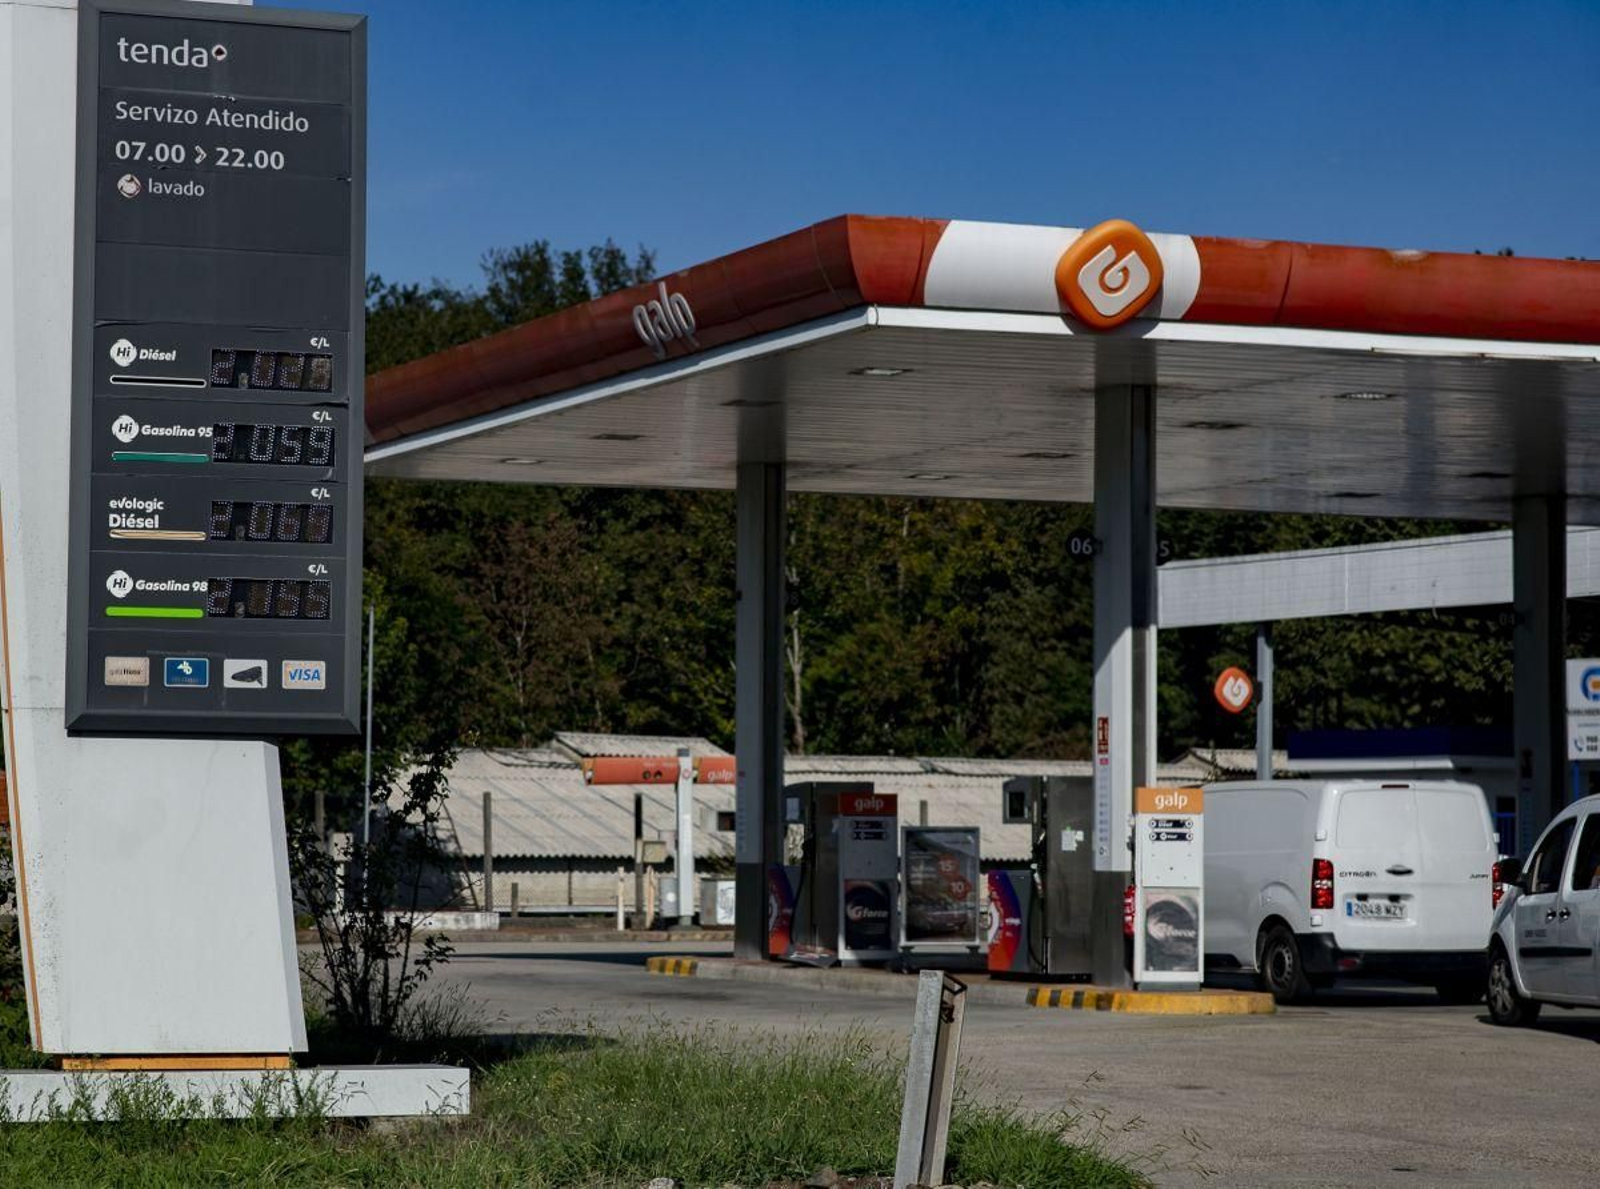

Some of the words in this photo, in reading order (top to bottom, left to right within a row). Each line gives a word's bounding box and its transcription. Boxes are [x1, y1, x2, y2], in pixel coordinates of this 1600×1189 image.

[117, 37, 209, 68] tenda
[115, 101, 198, 125] Servizo
[205, 107, 309, 133] Atendido
[115, 140, 186, 164] 07.00
[215, 147, 285, 170] 22.00
[148, 177, 205, 197] lavado
[633, 281, 699, 360] galp
[139, 348, 177, 361] Diésel
[141, 424, 196, 438] Gasolina
[197, 426, 213, 438] 95
[108, 496, 165, 512] evologic
[108, 513, 160, 529] Diésel
[1070, 537, 1093, 555] 06
[135, 579, 191, 593] Gasolina
[192, 580, 208, 592] 98
[289, 668, 321, 681] VISA
[707, 770, 735, 782] galp
[854, 794, 885, 811] galp
[1154, 791, 1188, 810] galp
